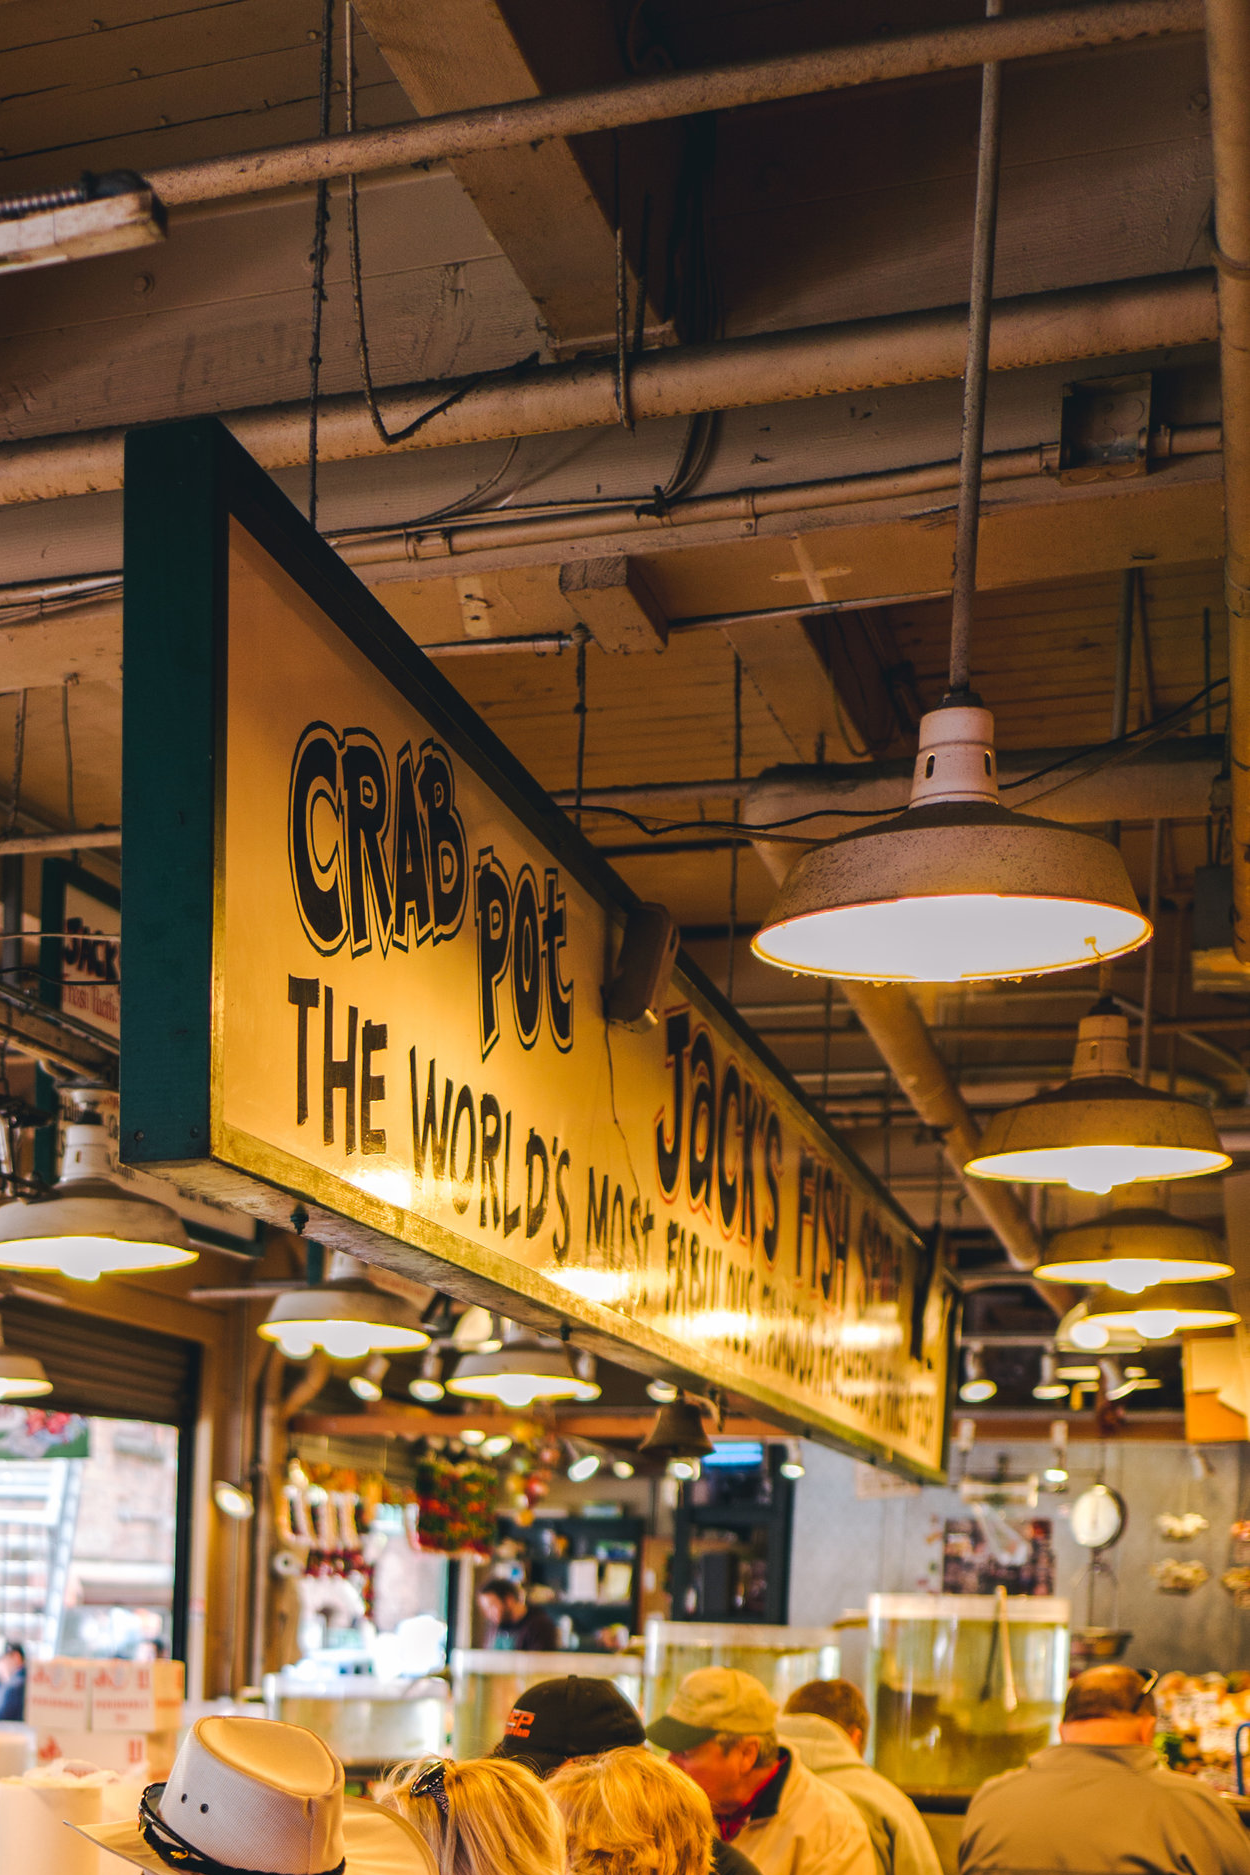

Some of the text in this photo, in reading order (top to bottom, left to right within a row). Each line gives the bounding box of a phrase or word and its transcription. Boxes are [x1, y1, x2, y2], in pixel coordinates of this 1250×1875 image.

[288, 720, 469, 960] CRAB
[288, 973, 388, 1156] THE
[409, 1045, 572, 1264] WORLD'S
